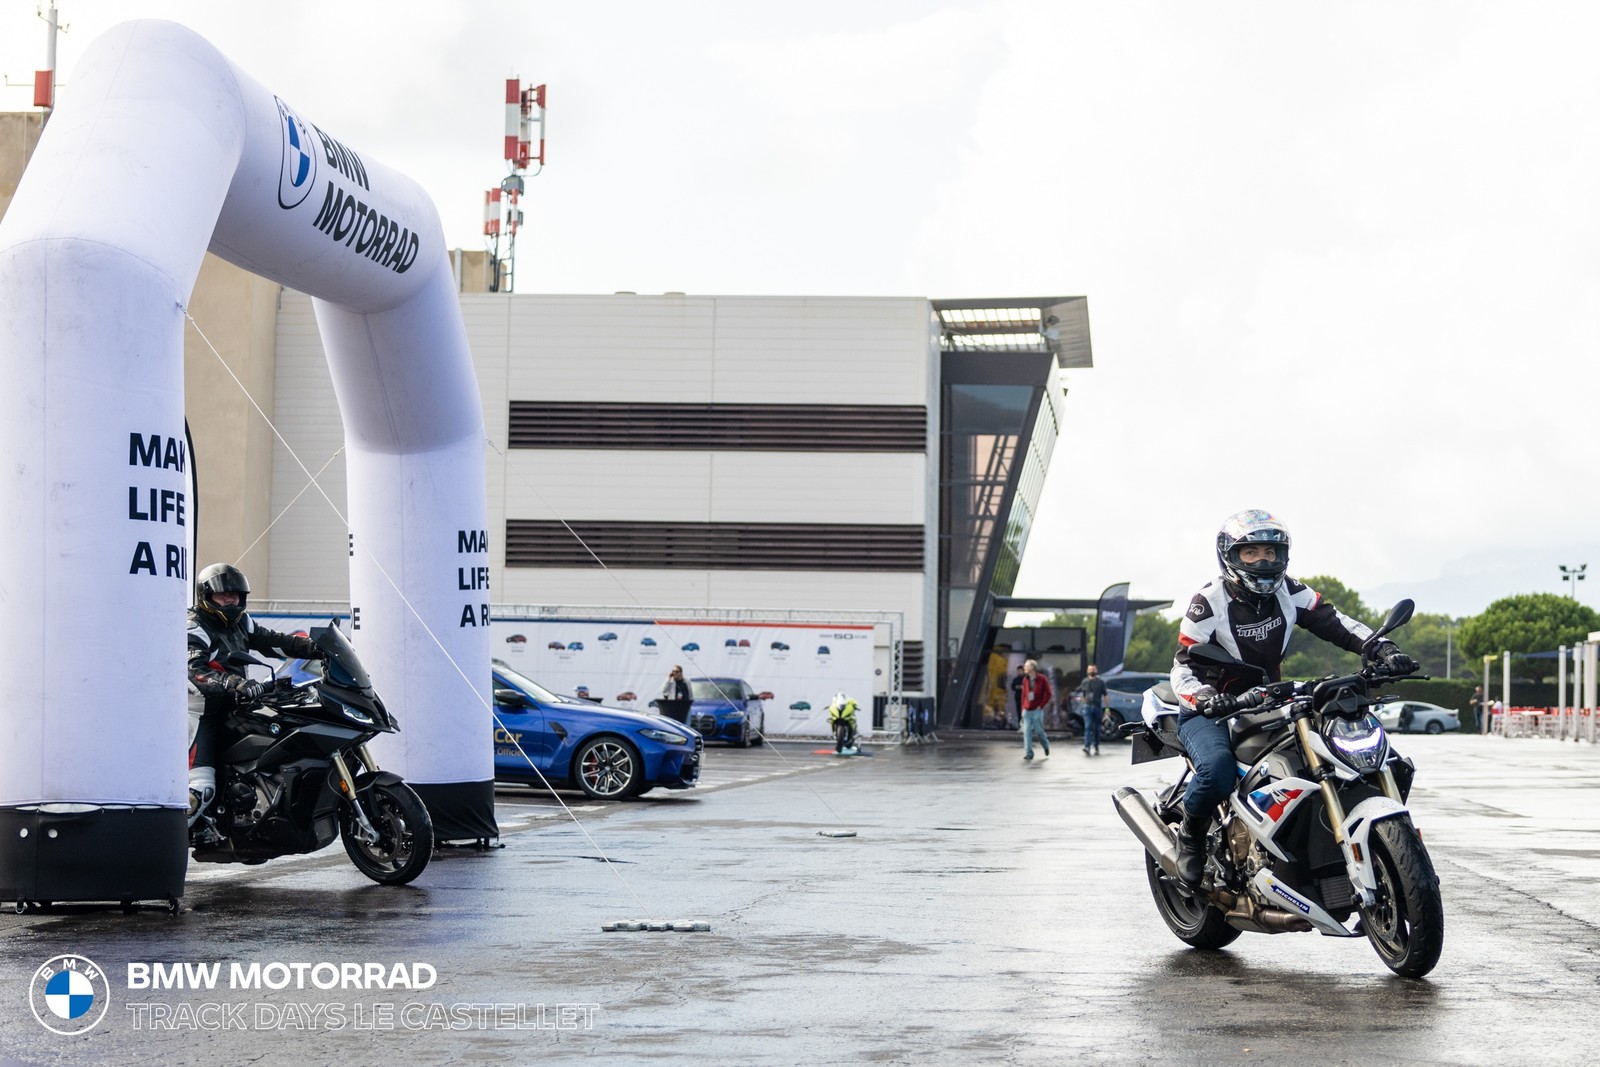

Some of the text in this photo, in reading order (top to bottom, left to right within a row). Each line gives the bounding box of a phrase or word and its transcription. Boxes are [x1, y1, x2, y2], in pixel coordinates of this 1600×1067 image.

[310, 122, 370, 191] BMW
[312, 180, 420, 274] MOTORRAD
[129, 486, 185, 527] LIFE
[129, 541, 158, 576] A
[460, 604, 477, 628] A
[494, 728, 523, 744] Car
[1275, 886, 1309, 913] MICHELIN
